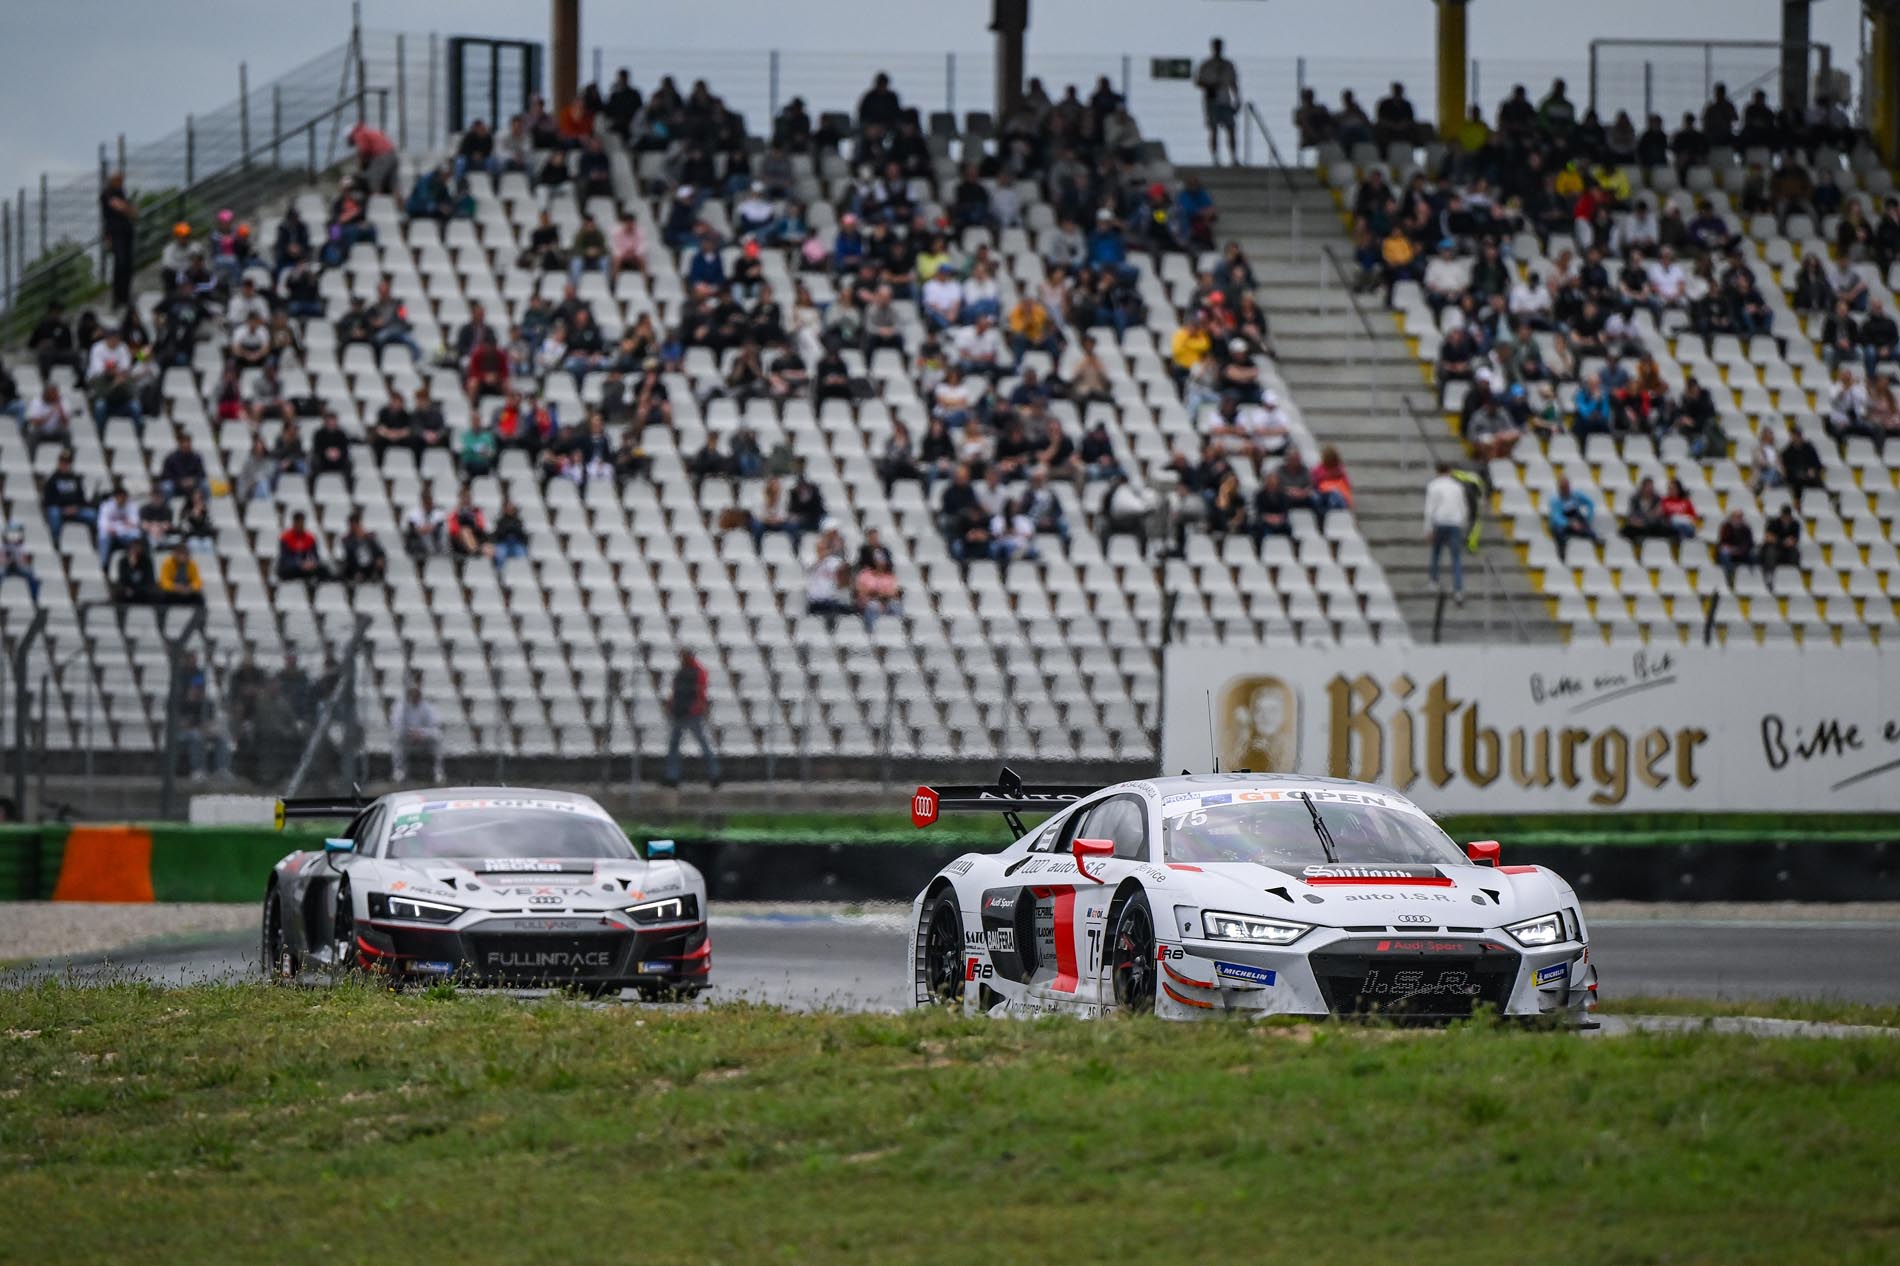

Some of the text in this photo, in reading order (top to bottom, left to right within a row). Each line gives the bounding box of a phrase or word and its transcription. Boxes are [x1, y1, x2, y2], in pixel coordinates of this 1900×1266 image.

[1530, 672, 1583, 704] Bitte
[1327, 671, 1708, 806] Bitburger
[1760, 714, 1863, 770] Bitte
[1173, 809, 1208, 832] 75
[390, 821, 424, 842] 22
[1047, 862, 1074, 873] auto
[493, 887, 593, 897] VEXTA
[1344, 892, 1394, 902] auto
[1394, 941, 1464, 951] Audi Sport
[487, 951, 609, 966] FULLINRACE
[1223, 967, 1268, 980] MICHELIN
